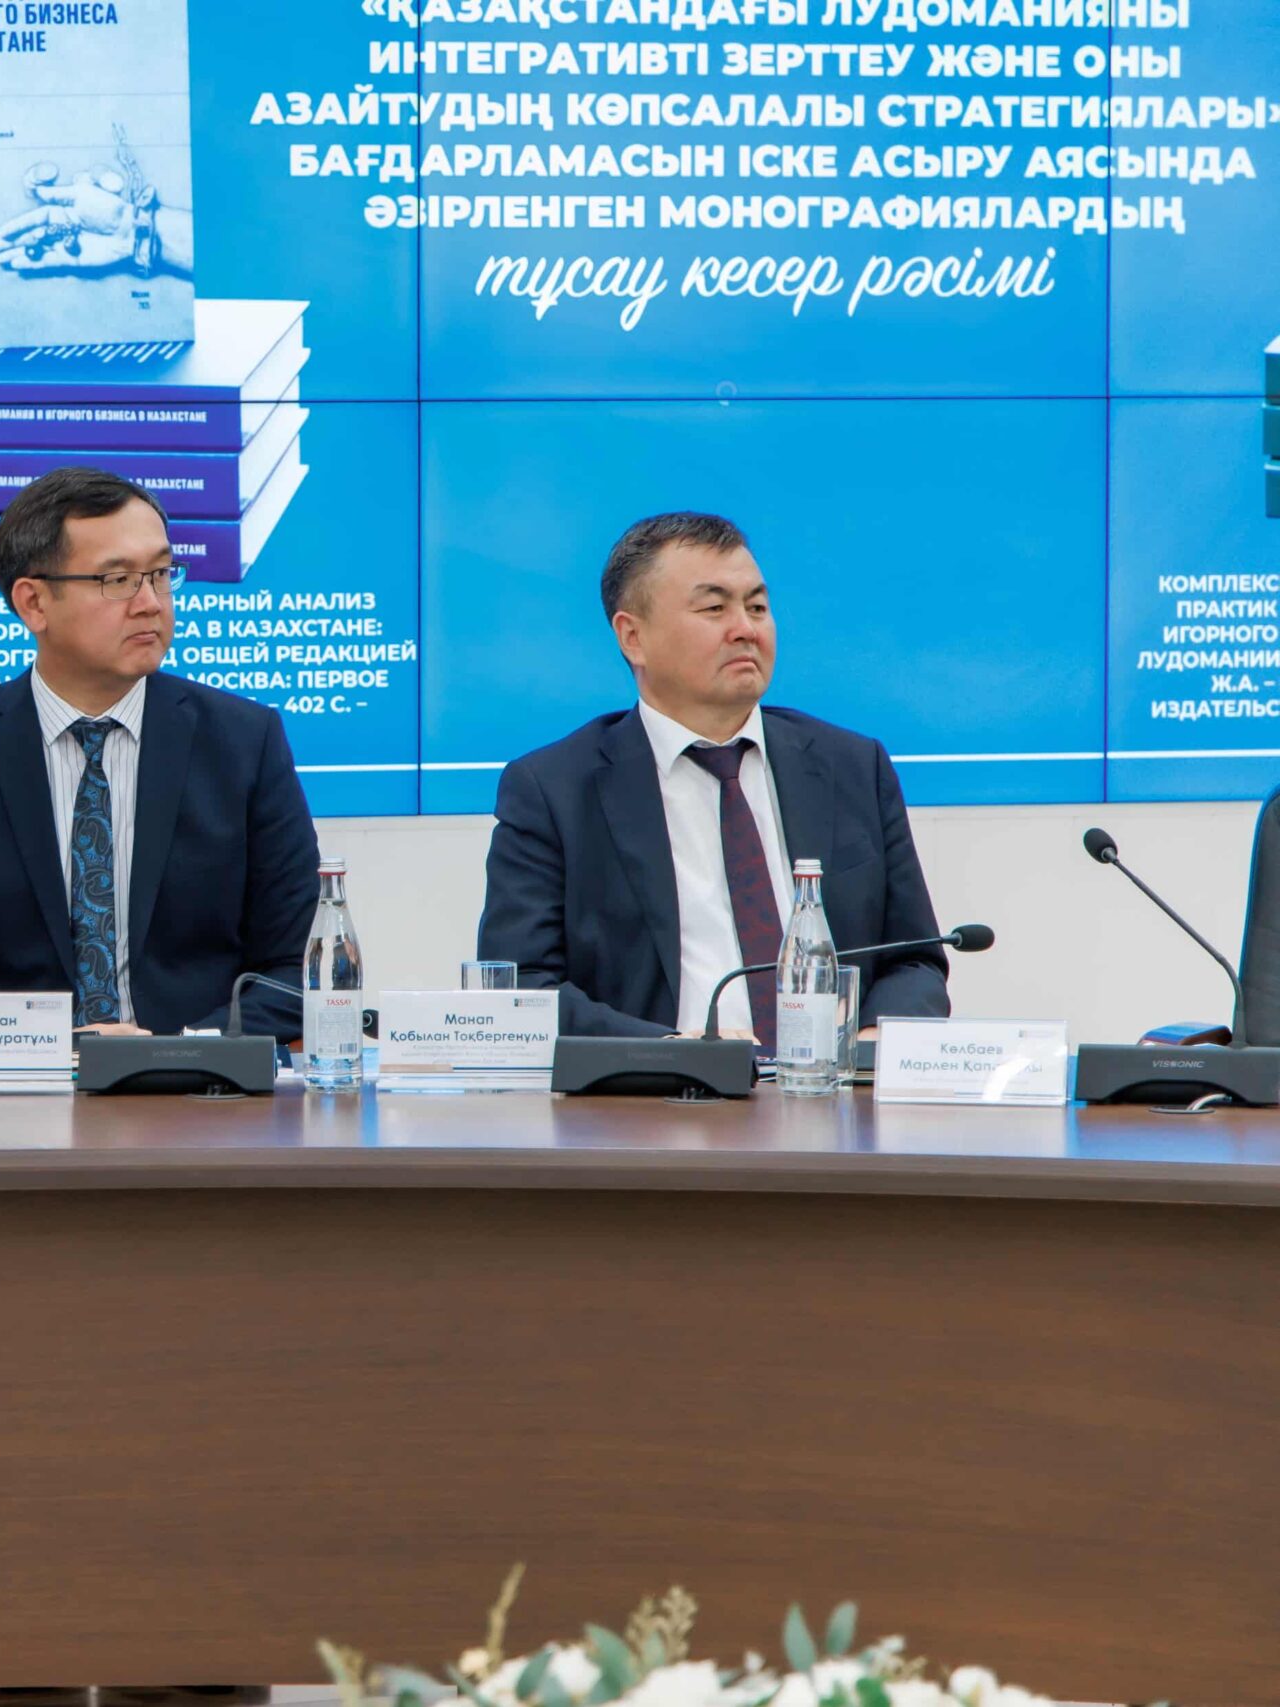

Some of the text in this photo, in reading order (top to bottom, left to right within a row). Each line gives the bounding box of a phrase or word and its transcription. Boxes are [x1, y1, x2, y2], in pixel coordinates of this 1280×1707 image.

[24, 3, 119, 25] БИЗНЕСА
[369, 40, 1181, 79] ИНТЕГРАТИВТІ ЗЕРТТЕУ ЖӘНЕ ОНЫ
[250, 83, 554, 131] АЗАЙТУДЫҢ
[567, 93, 865, 128] КӨПСАЛАЛЫ
[289, 144, 1257, 185] БАҒДАРЛАМАСЫН ІСКЕ АСЫРУ АЯСЫНДА
[363, 194, 1185, 235] ӘЗІРЛЕНГЕН МОНОГРАФИЯЛАРДЫҢ
[681, 254, 844, 317] кесер
[36, 409, 43, 420] И
[45, 409, 93, 421] ИГОРНОГО
[94, 410, 137, 422] БИЗНЕСА
[138, 410, 145, 422] В
[146, 411, 207, 423] КАЗАХСТАНЕ
[144, 478, 205, 491] КАЗАХСТАНЕ
[279, 593, 376, 611] АНАЛИЗ
[1176, 600, 1278, 619] ПРАКТИК
[208, 622, 222, 637] В
[228, 618, 383, 637] КАЗАХСТАНЕ:
[1163, 625, 1279, 644] ИГОРНОГО
[183, 642, 270, 667] ОБЩЕЙ
[276, 640, 417, 664] РЕДАКЦИЕЙ
[1137, 650, 1280, 672] ЛУДОМАНИИ
[297, 670, 389, 688] ПЕРВОЕ
[1211, 675, 1259, 693] Ж.А.
[284, 696, 325, 714] 402
[330, 696, 351, 713] С.
[782, 1001, 805, 1009] TASSAY
[444, 1013, 494, 1025] Манап
[390, 1030, 549, 1044] Қобылан Тоқбергенұлы
[940, 1042, 1003, 1055] Көлбаев
[899, 1059, 959, 1073] Марлен
